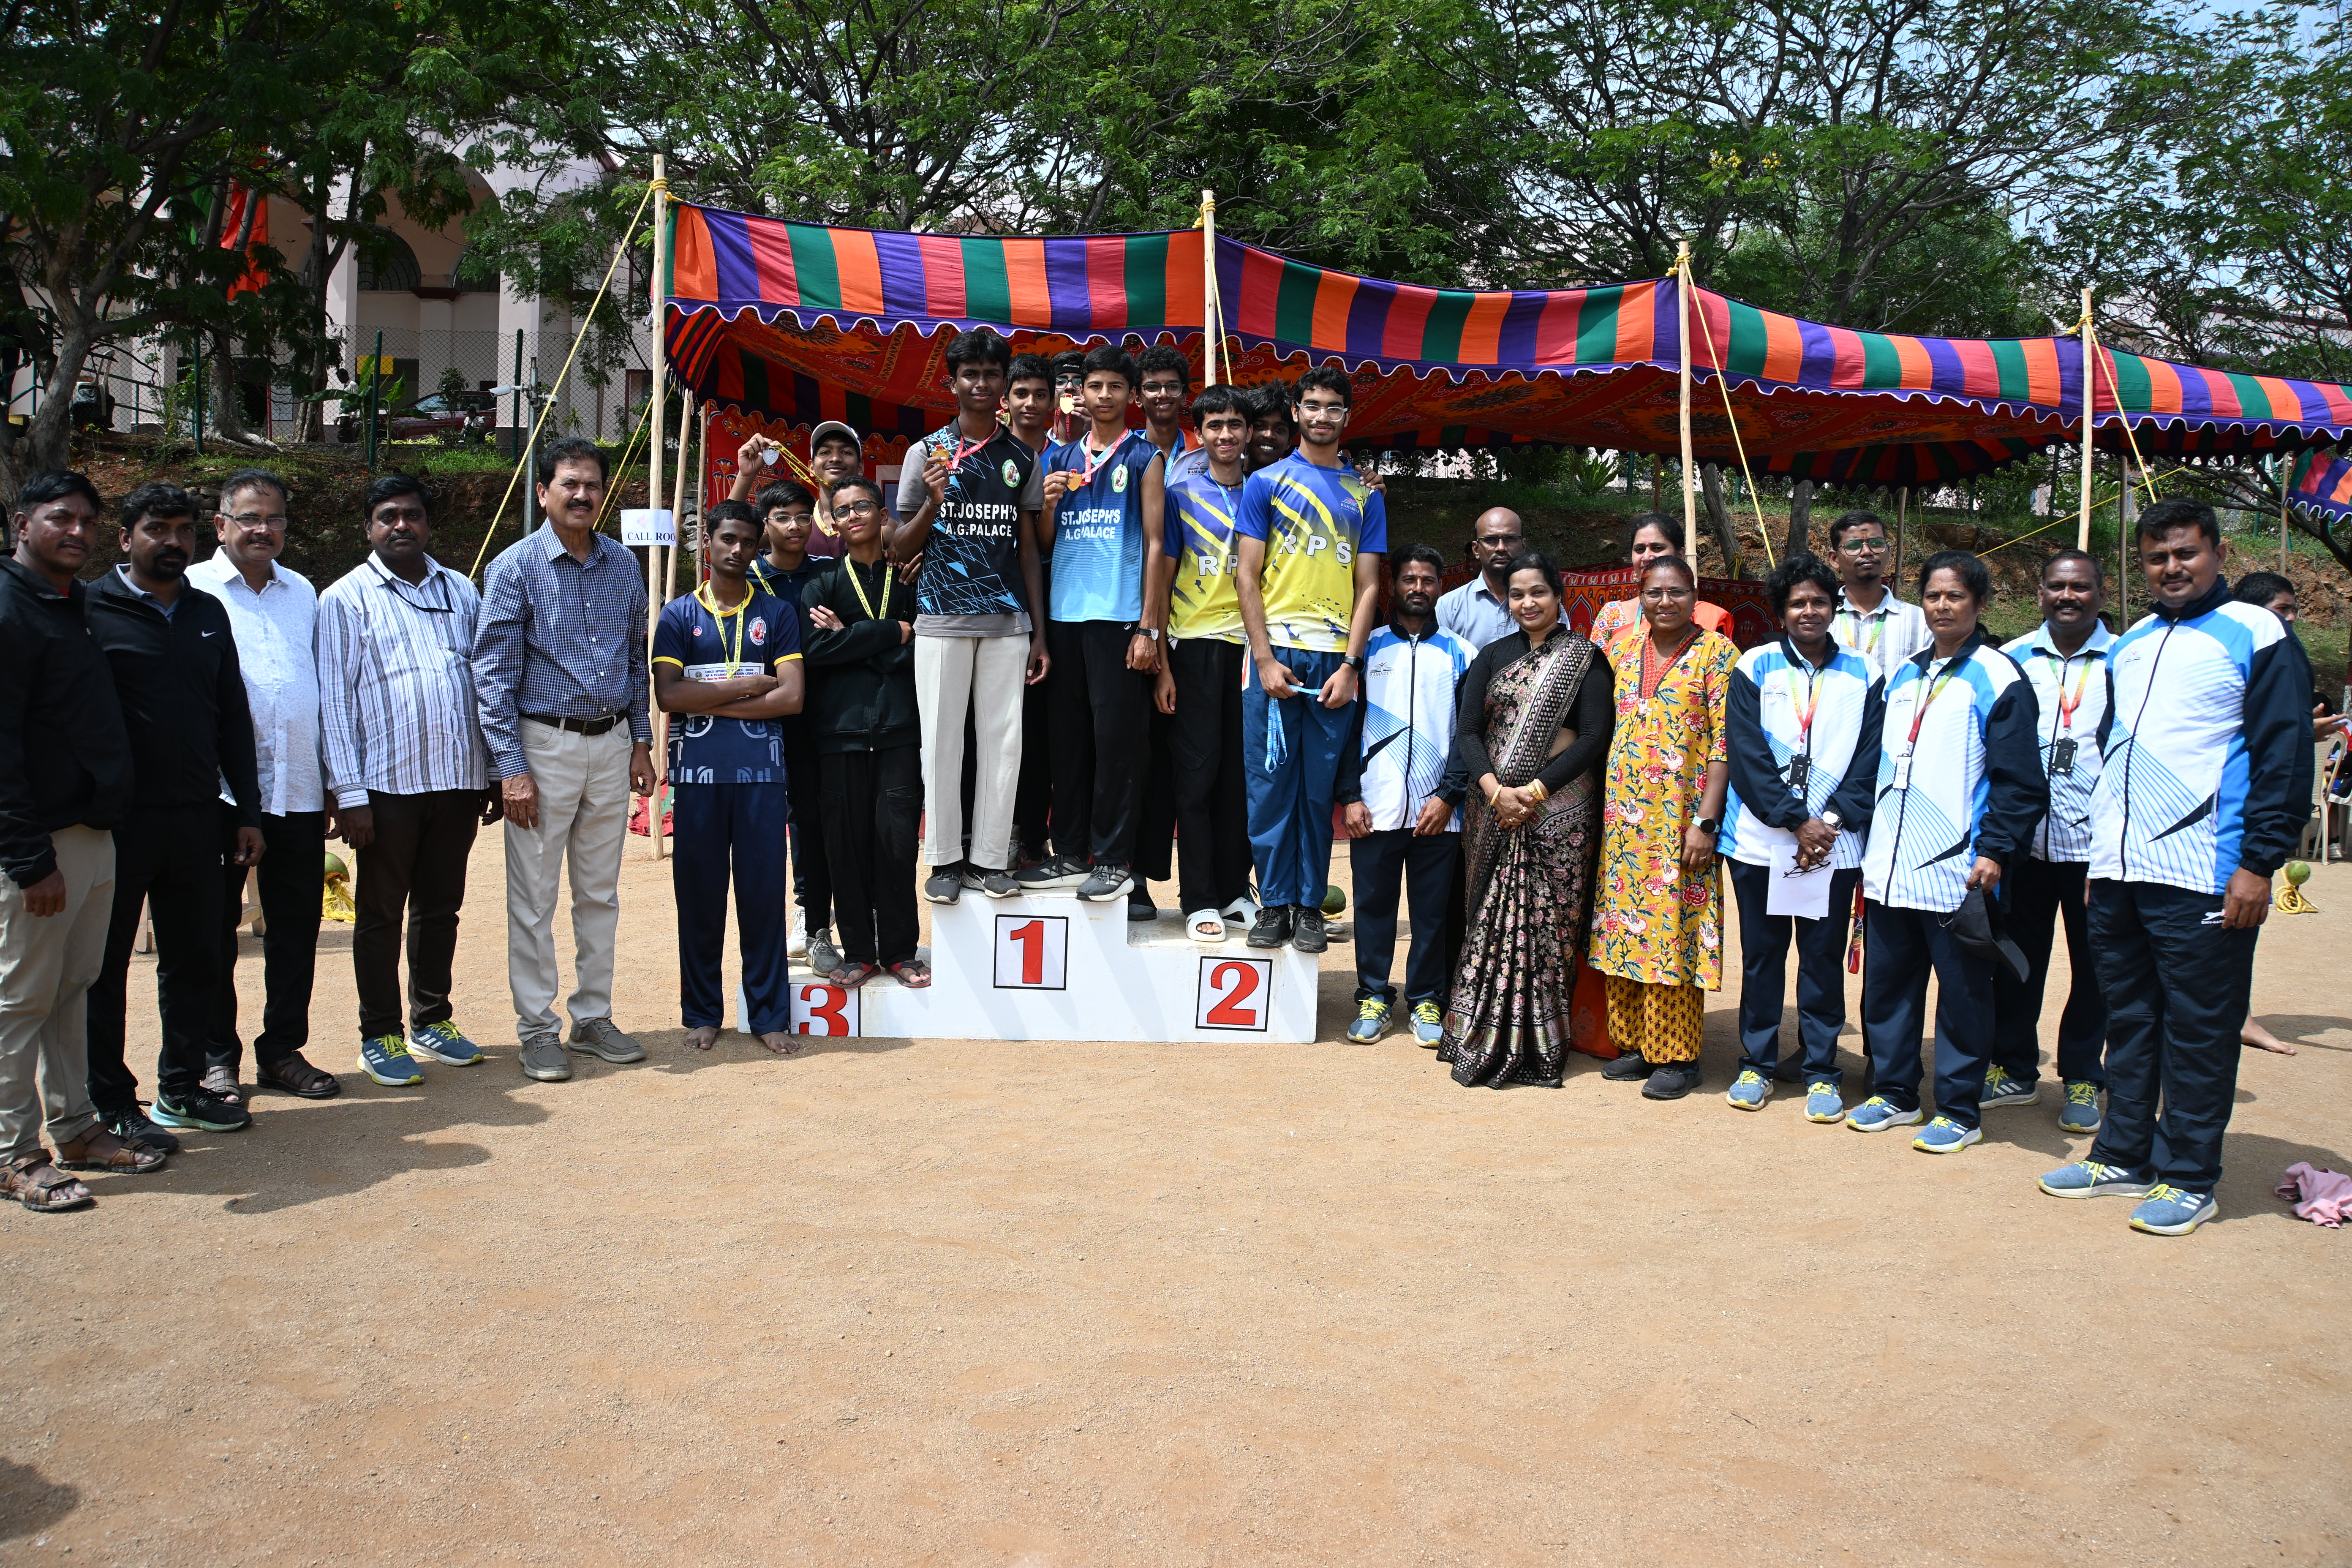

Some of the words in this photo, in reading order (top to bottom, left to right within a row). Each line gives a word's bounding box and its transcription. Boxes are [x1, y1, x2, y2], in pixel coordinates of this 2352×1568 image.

[940, 502, 1017, 522] ST.JOSEPH'S
[945, 523, 1012, 537] A.G.PALACE
[627, 532, 652, 541] CALL
[1010, 920, 1044, 984] 1
[799, 984, 849, 1037] 3
[1207, 962, 1260, 1026] 2
